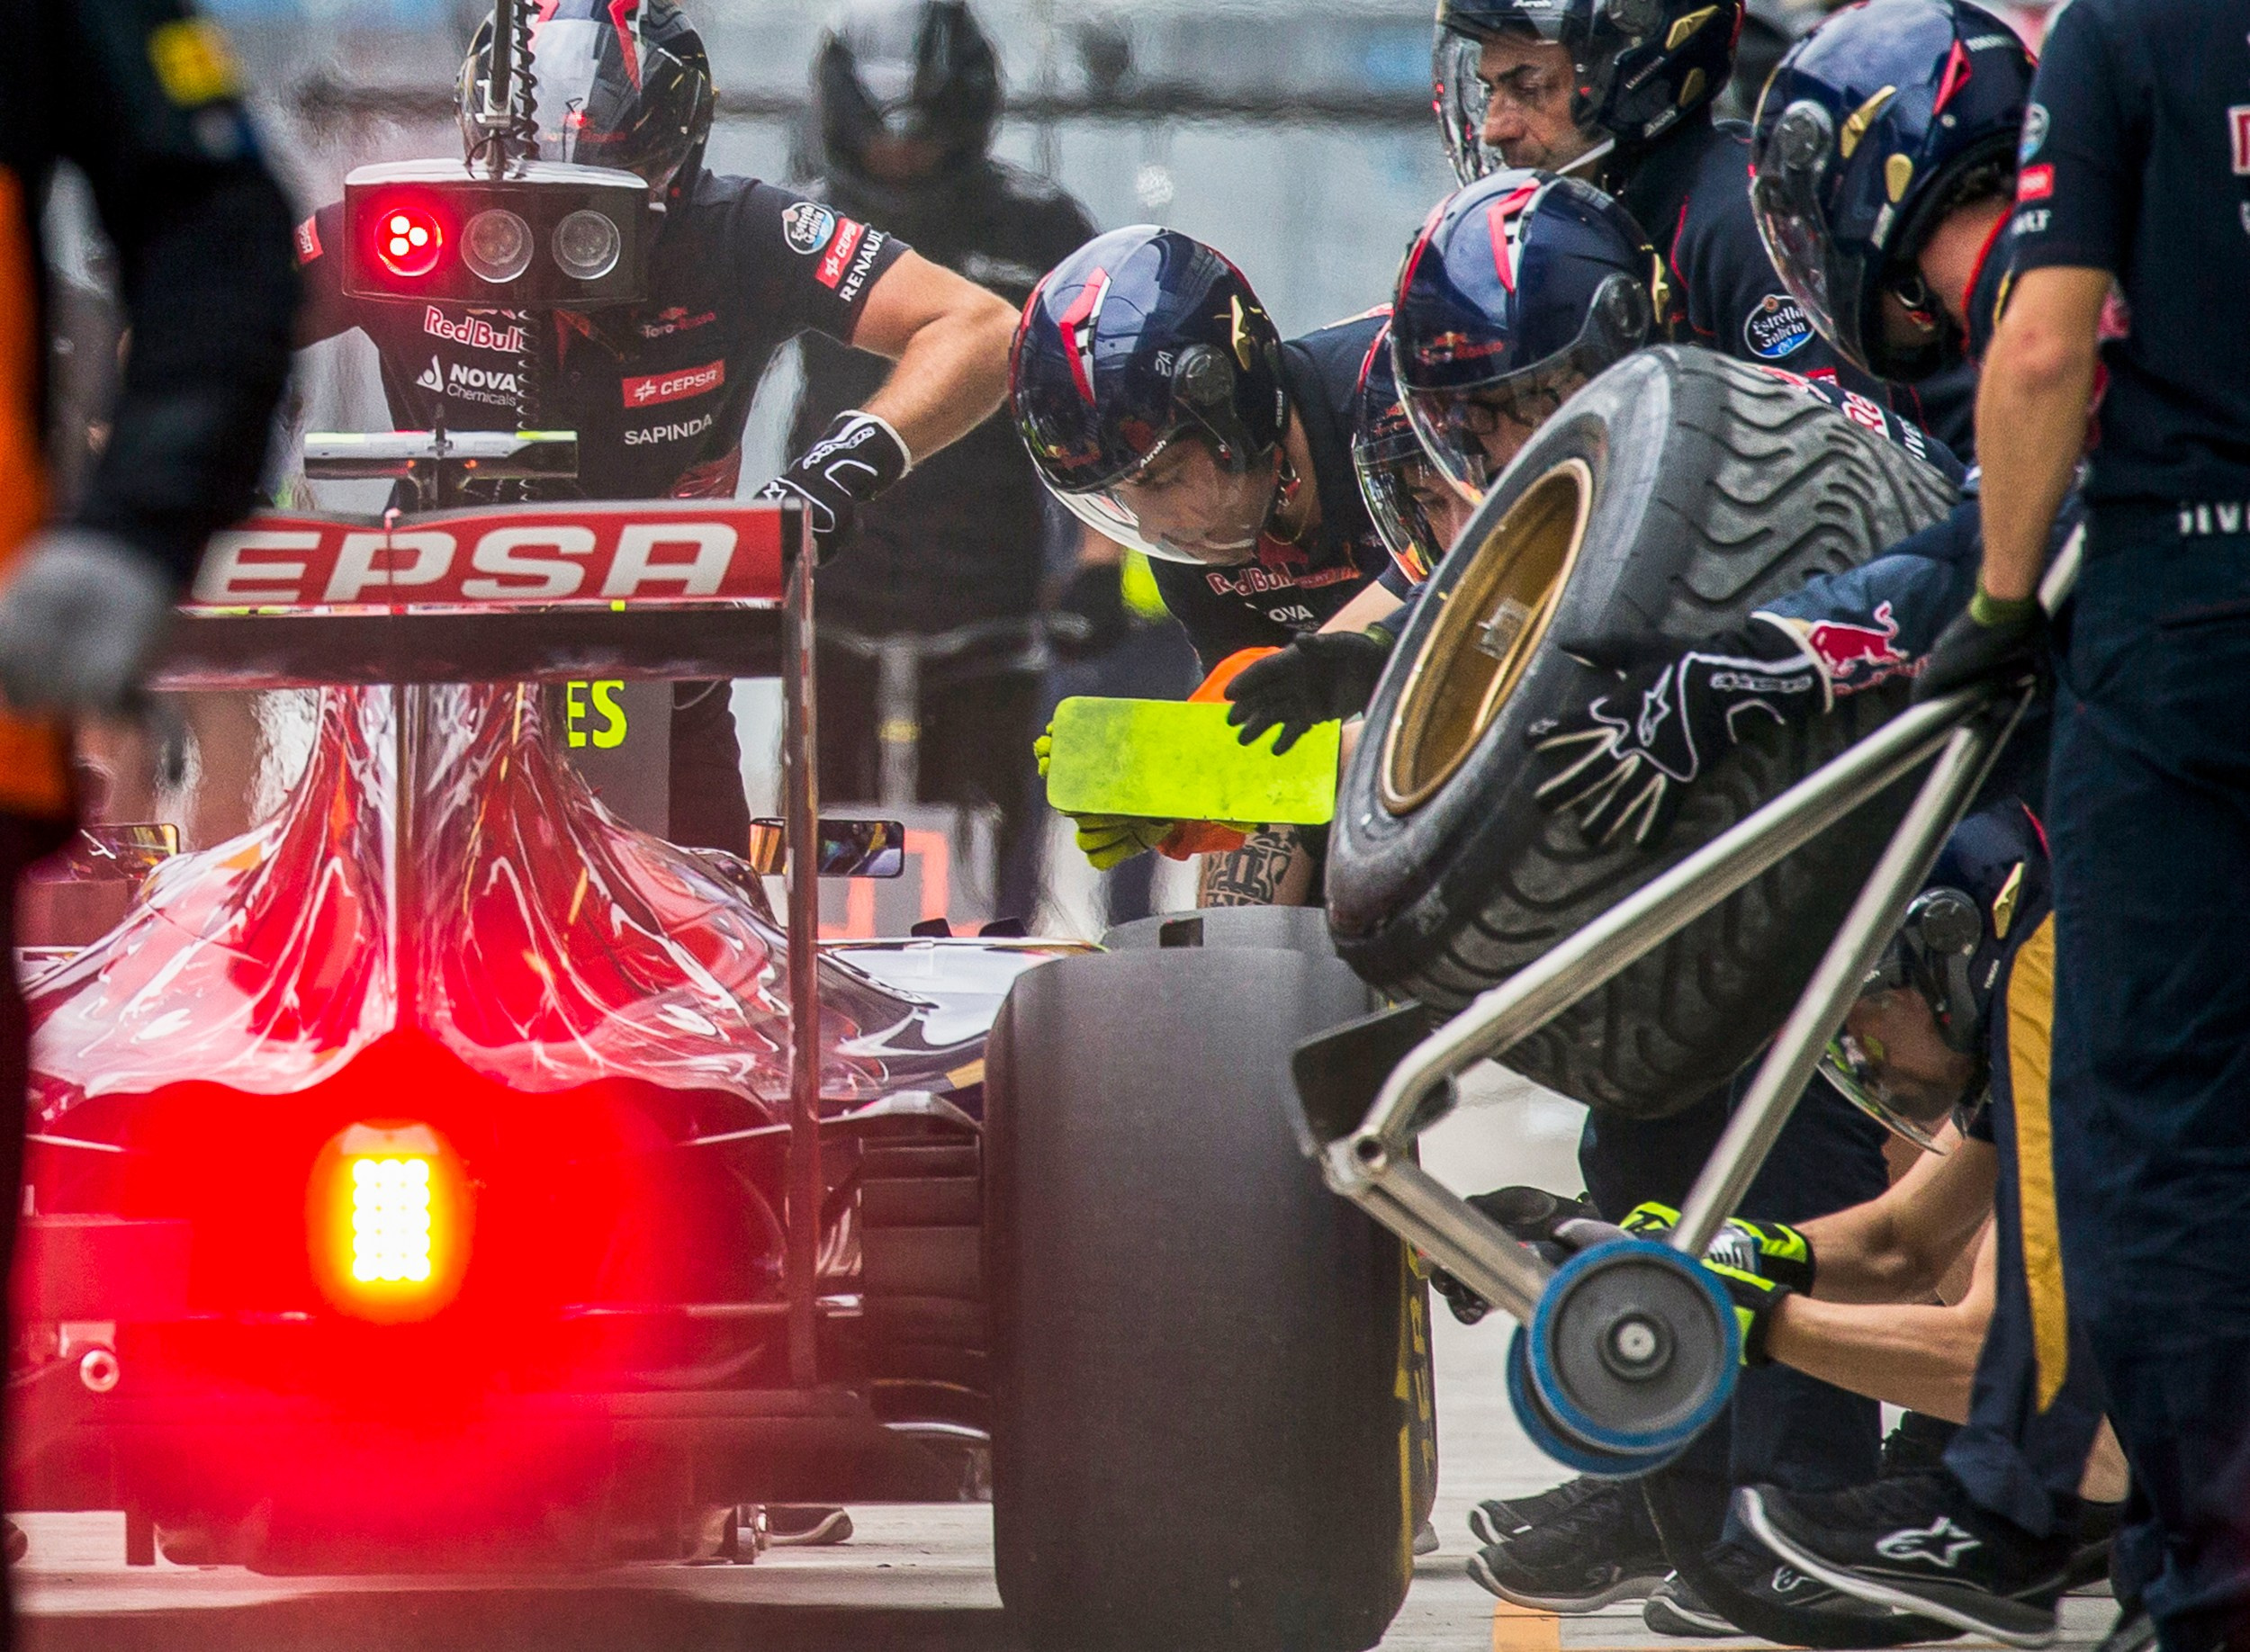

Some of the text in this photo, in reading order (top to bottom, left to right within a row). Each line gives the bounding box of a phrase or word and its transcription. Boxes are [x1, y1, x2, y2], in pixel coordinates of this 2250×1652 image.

[834, 222, 858, 258] CEPS
[450, 364, 518, 393] NOVA
[661, 370, 718, 396] CEPSA
[446, 382, 518, 406] Chemicals
[624, 413, 714, 445] SAPINDA
[190, 522, 738, 604] EPSA
[1268, 604, 1315, 623] OVA
[566, 679, 628, 750] ES
